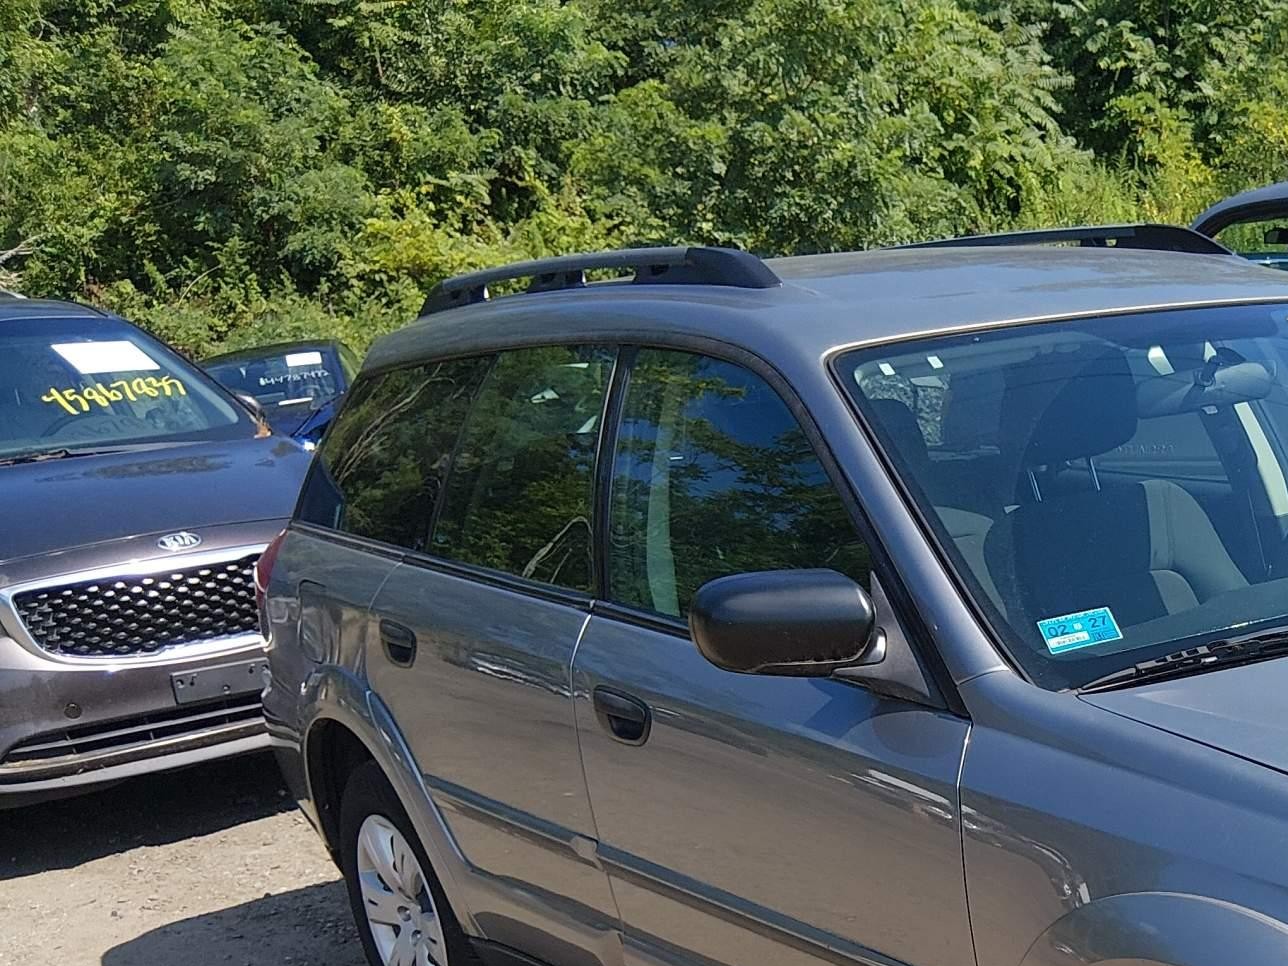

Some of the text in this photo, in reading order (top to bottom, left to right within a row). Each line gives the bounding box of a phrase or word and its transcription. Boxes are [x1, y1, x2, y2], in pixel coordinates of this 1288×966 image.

[160, 533, 200, 549] KIA
[1047, 624, 1069, 638] 02
[1088, 615, 1107, 629] 27
